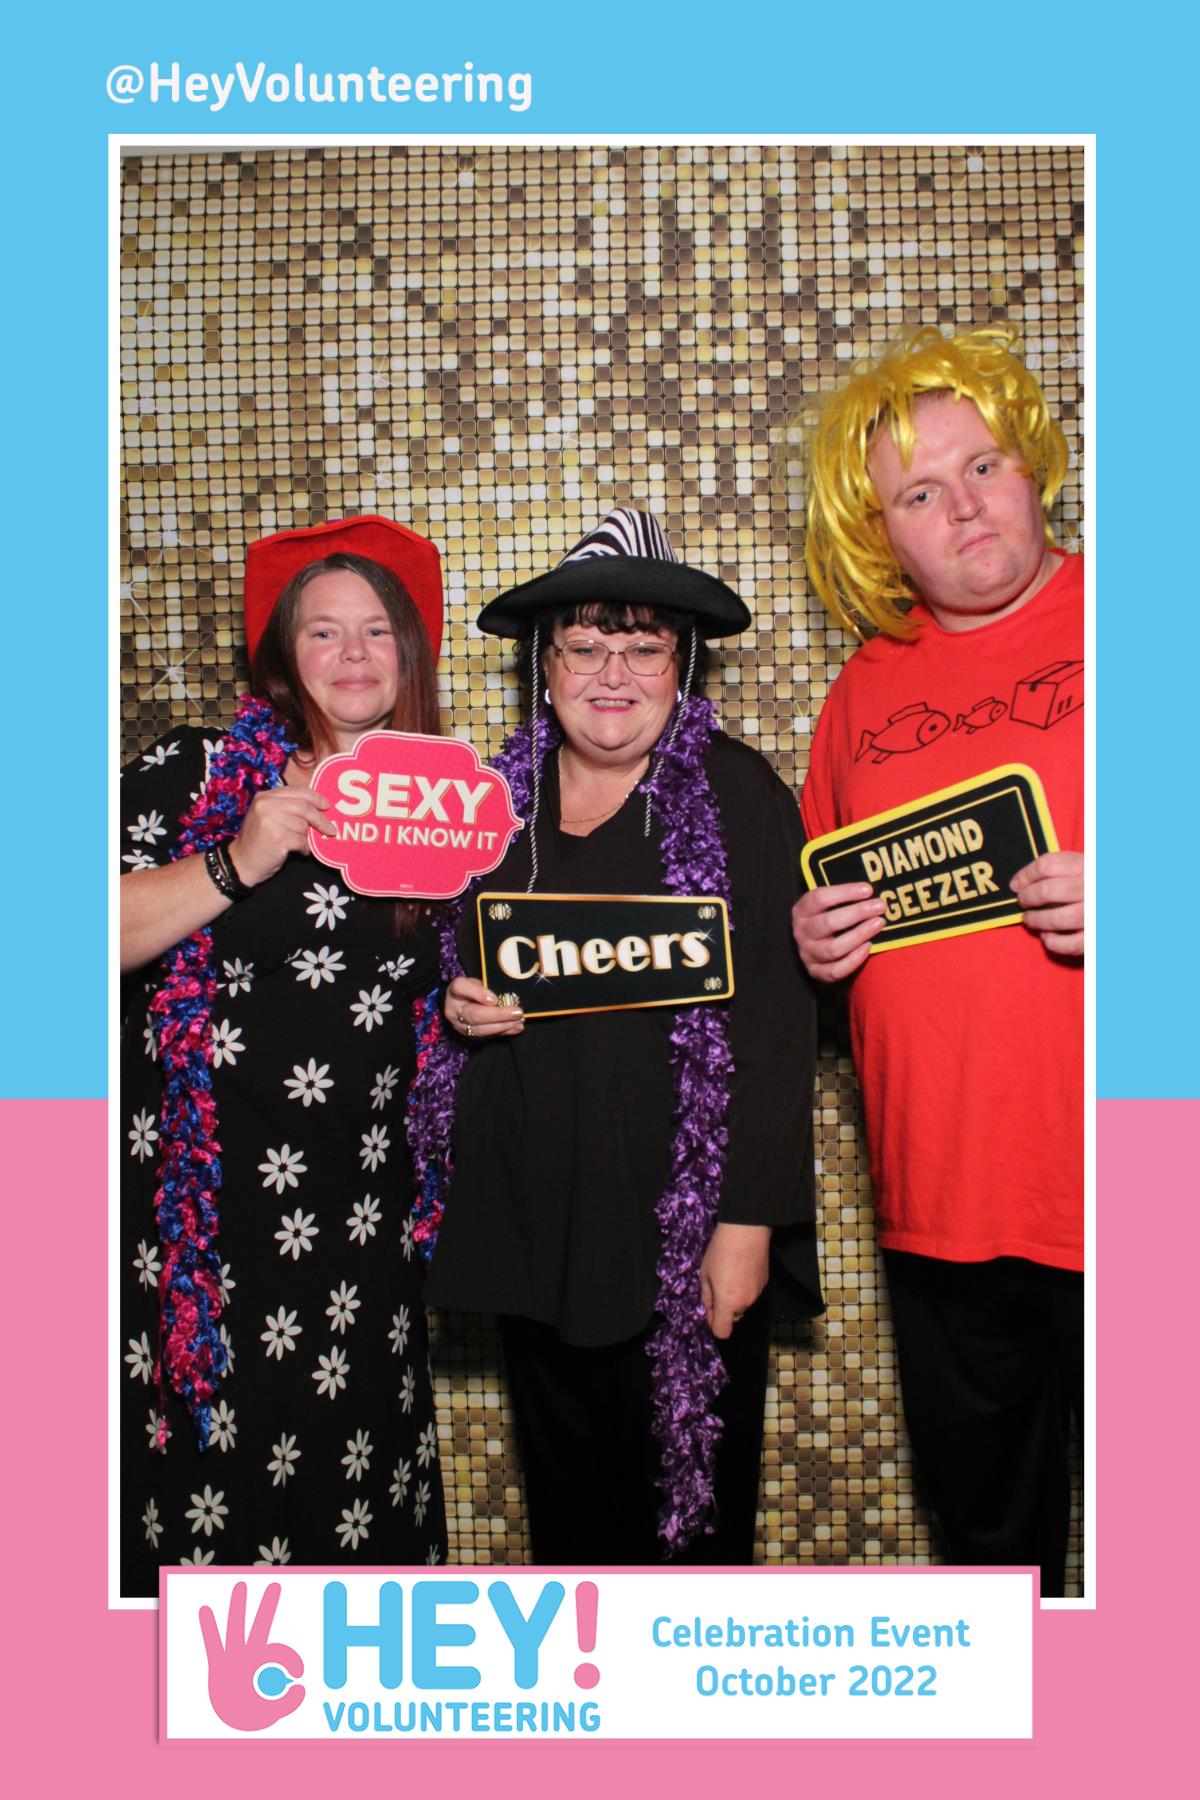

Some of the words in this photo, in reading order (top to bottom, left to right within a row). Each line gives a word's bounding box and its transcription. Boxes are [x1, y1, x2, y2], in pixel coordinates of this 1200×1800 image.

[335, 769, 493, 824] SEXY
[384, 824, 392, 844] I
[397, 825, 473, 849] KNOW
[477, 831, 498, 850] IT
[860, 818, 984, 883] DIAMOND
[879, 861, 1001, 921] GEEZER
[497, 930, 711, 980] Cheers
